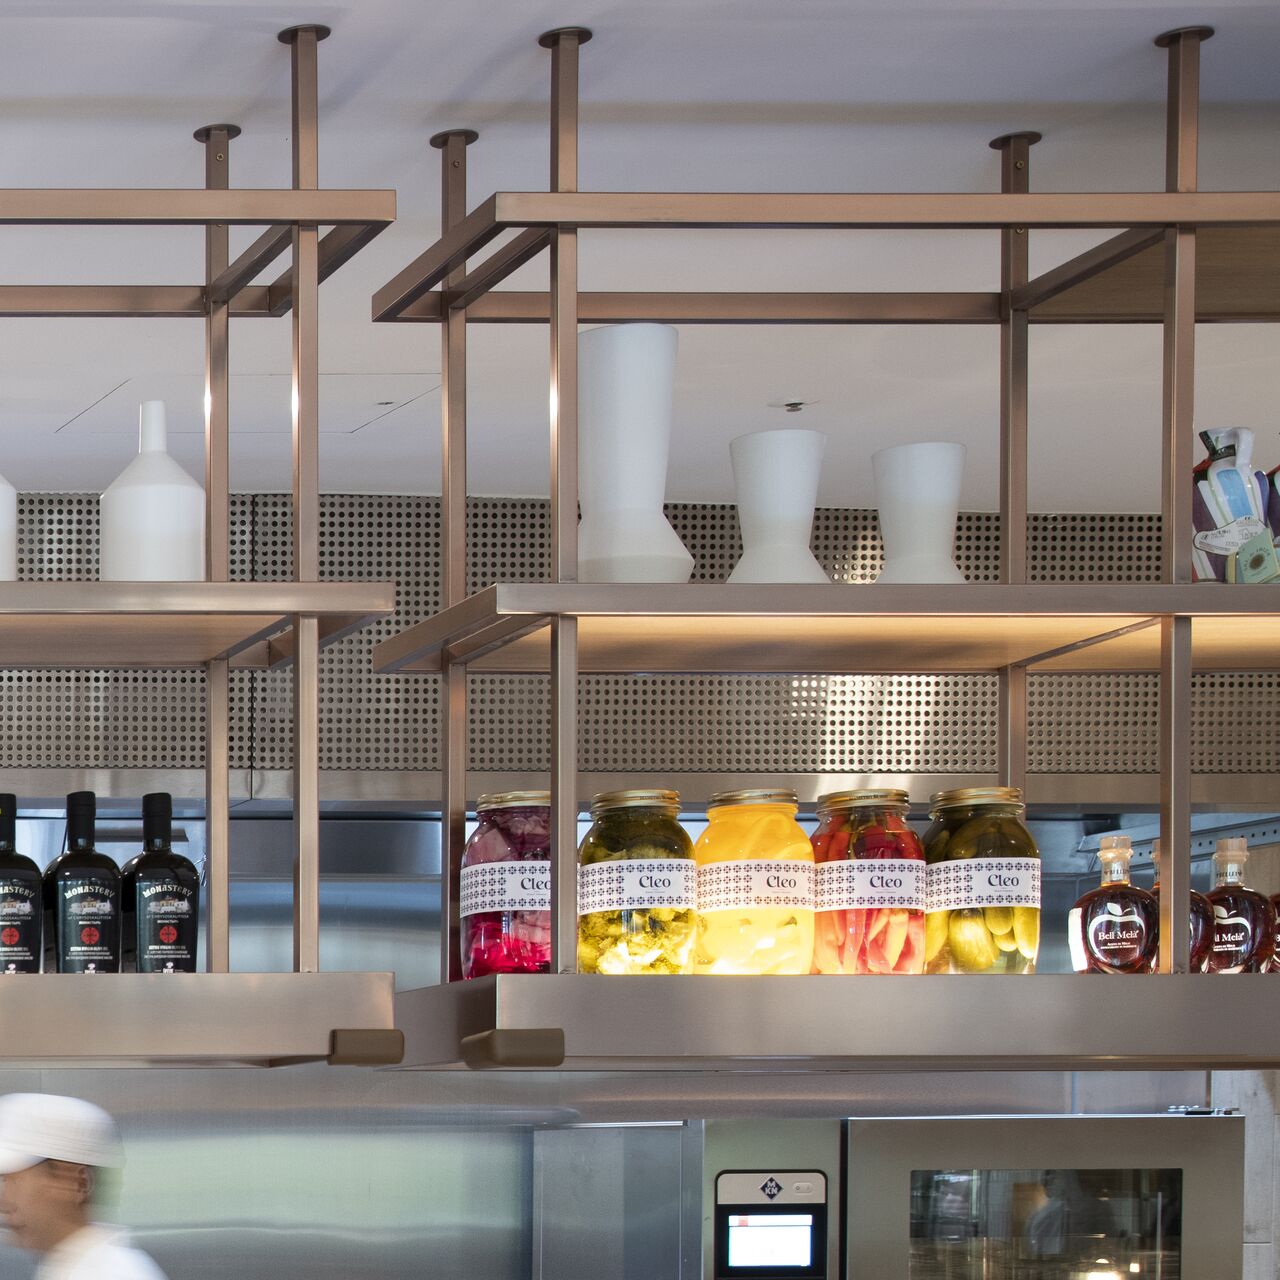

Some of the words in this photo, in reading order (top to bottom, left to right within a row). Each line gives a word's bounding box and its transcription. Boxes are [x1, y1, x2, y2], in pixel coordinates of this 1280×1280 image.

[638, 875, 671, 889] Cleo
[766, 875, 797, 888] Cleo
[869, 875, 903, 888] Cleo
[987, 874, 1020, 887] Cleo
[64, 885, 115, 899] MONASTERY
[142, 884, 192, 898] MONASTERY
